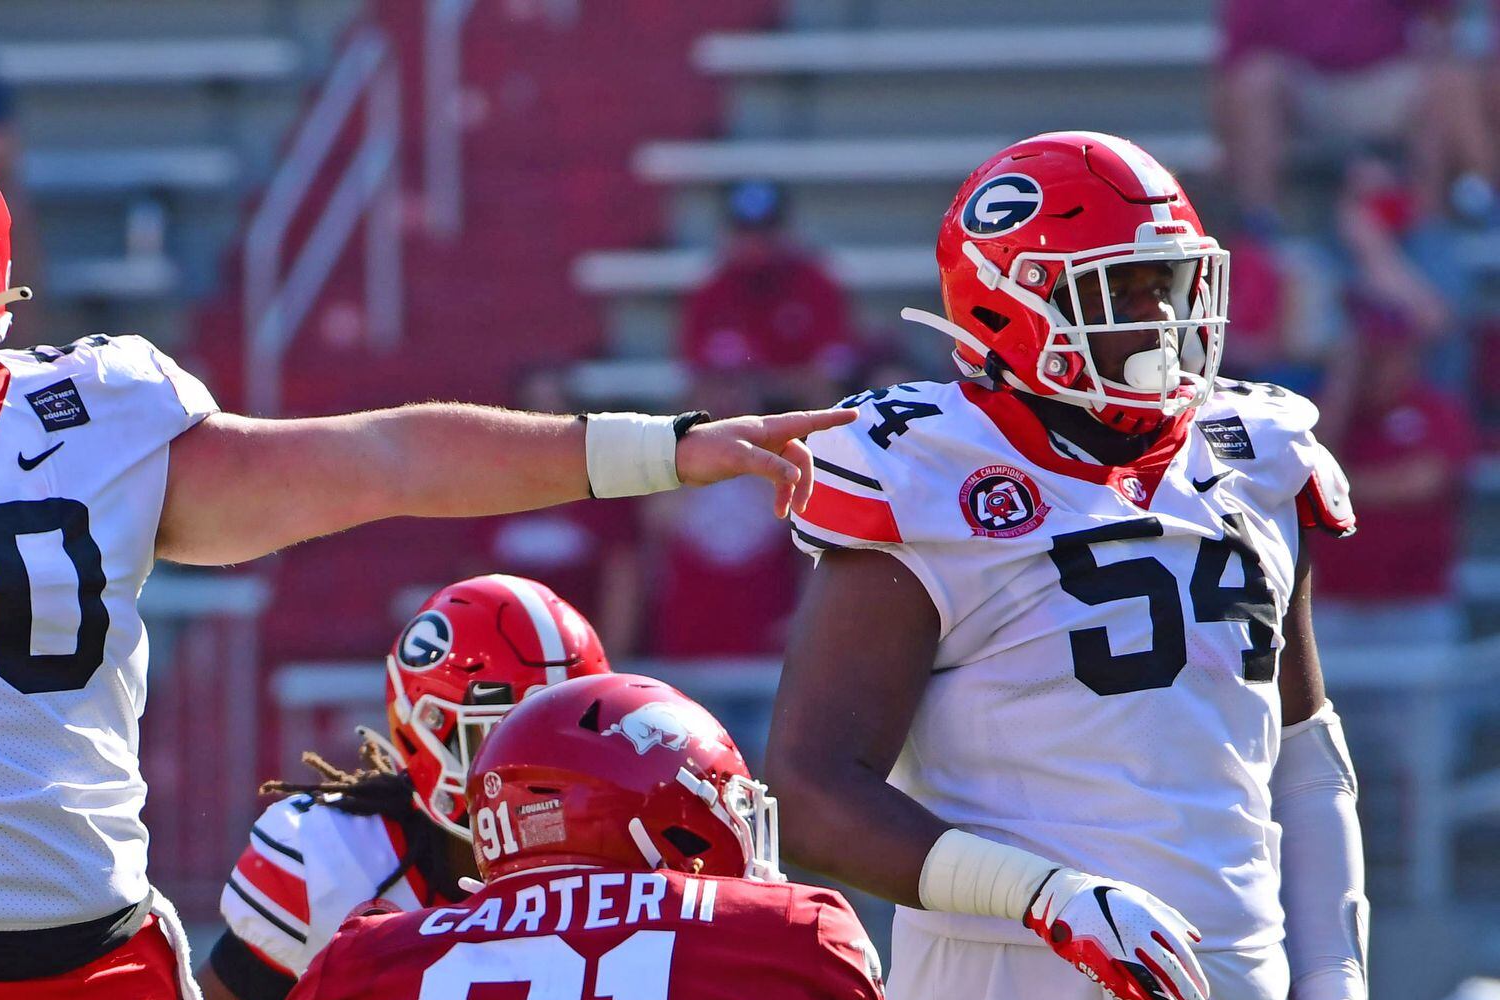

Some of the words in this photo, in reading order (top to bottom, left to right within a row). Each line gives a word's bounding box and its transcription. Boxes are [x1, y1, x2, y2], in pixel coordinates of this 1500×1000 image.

[962, 175, 1040, 236] G
[33, 389, 75, 407] TOGETHER
[43, 406, 81, 421] EQUALITY
[1212, 441, 1248, 449] EQUALITY
[980, 466, 1026, 482] CHAMPIONS
[1049, 513, 1278, 697] 54
[399, 611, 450, 670] G
[520, 799, 560, 815] EQUALITY
[477, 800, 519, 861] 91
[419, 872, 668, 936] CARTER
[680, 877, 717, 922] II
